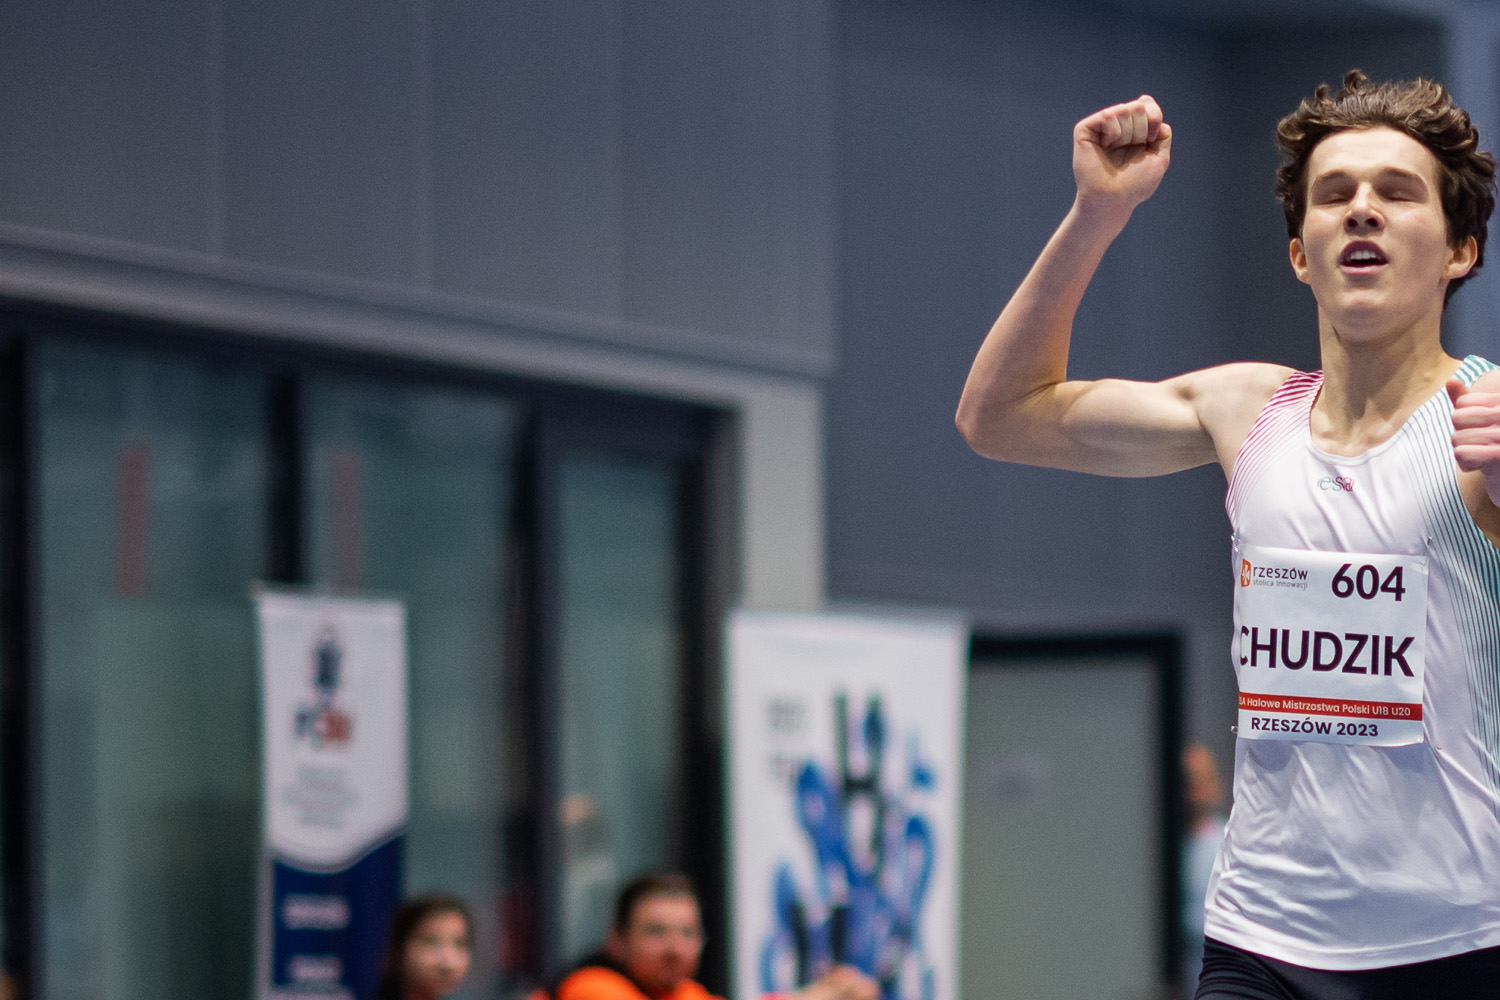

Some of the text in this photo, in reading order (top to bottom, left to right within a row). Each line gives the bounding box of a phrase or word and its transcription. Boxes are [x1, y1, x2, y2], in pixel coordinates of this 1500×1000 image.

[1253, 566, 1308, 580] rzeszów
[1331, 563, 1406, 602] 604
[1253, 578, 1308, 591] stolica innowacji
[1247, 698, 1281, 709] Halowe
[1282, 699, 1340, 713] Mistrzostwa
[1342, 703, 1370, 715] Polski
[1372, 705, 1389, 716] U18
[1391, 707, 1411, 717] U20
[1251, 716, 1379, 737] RZESZÓW 2023
